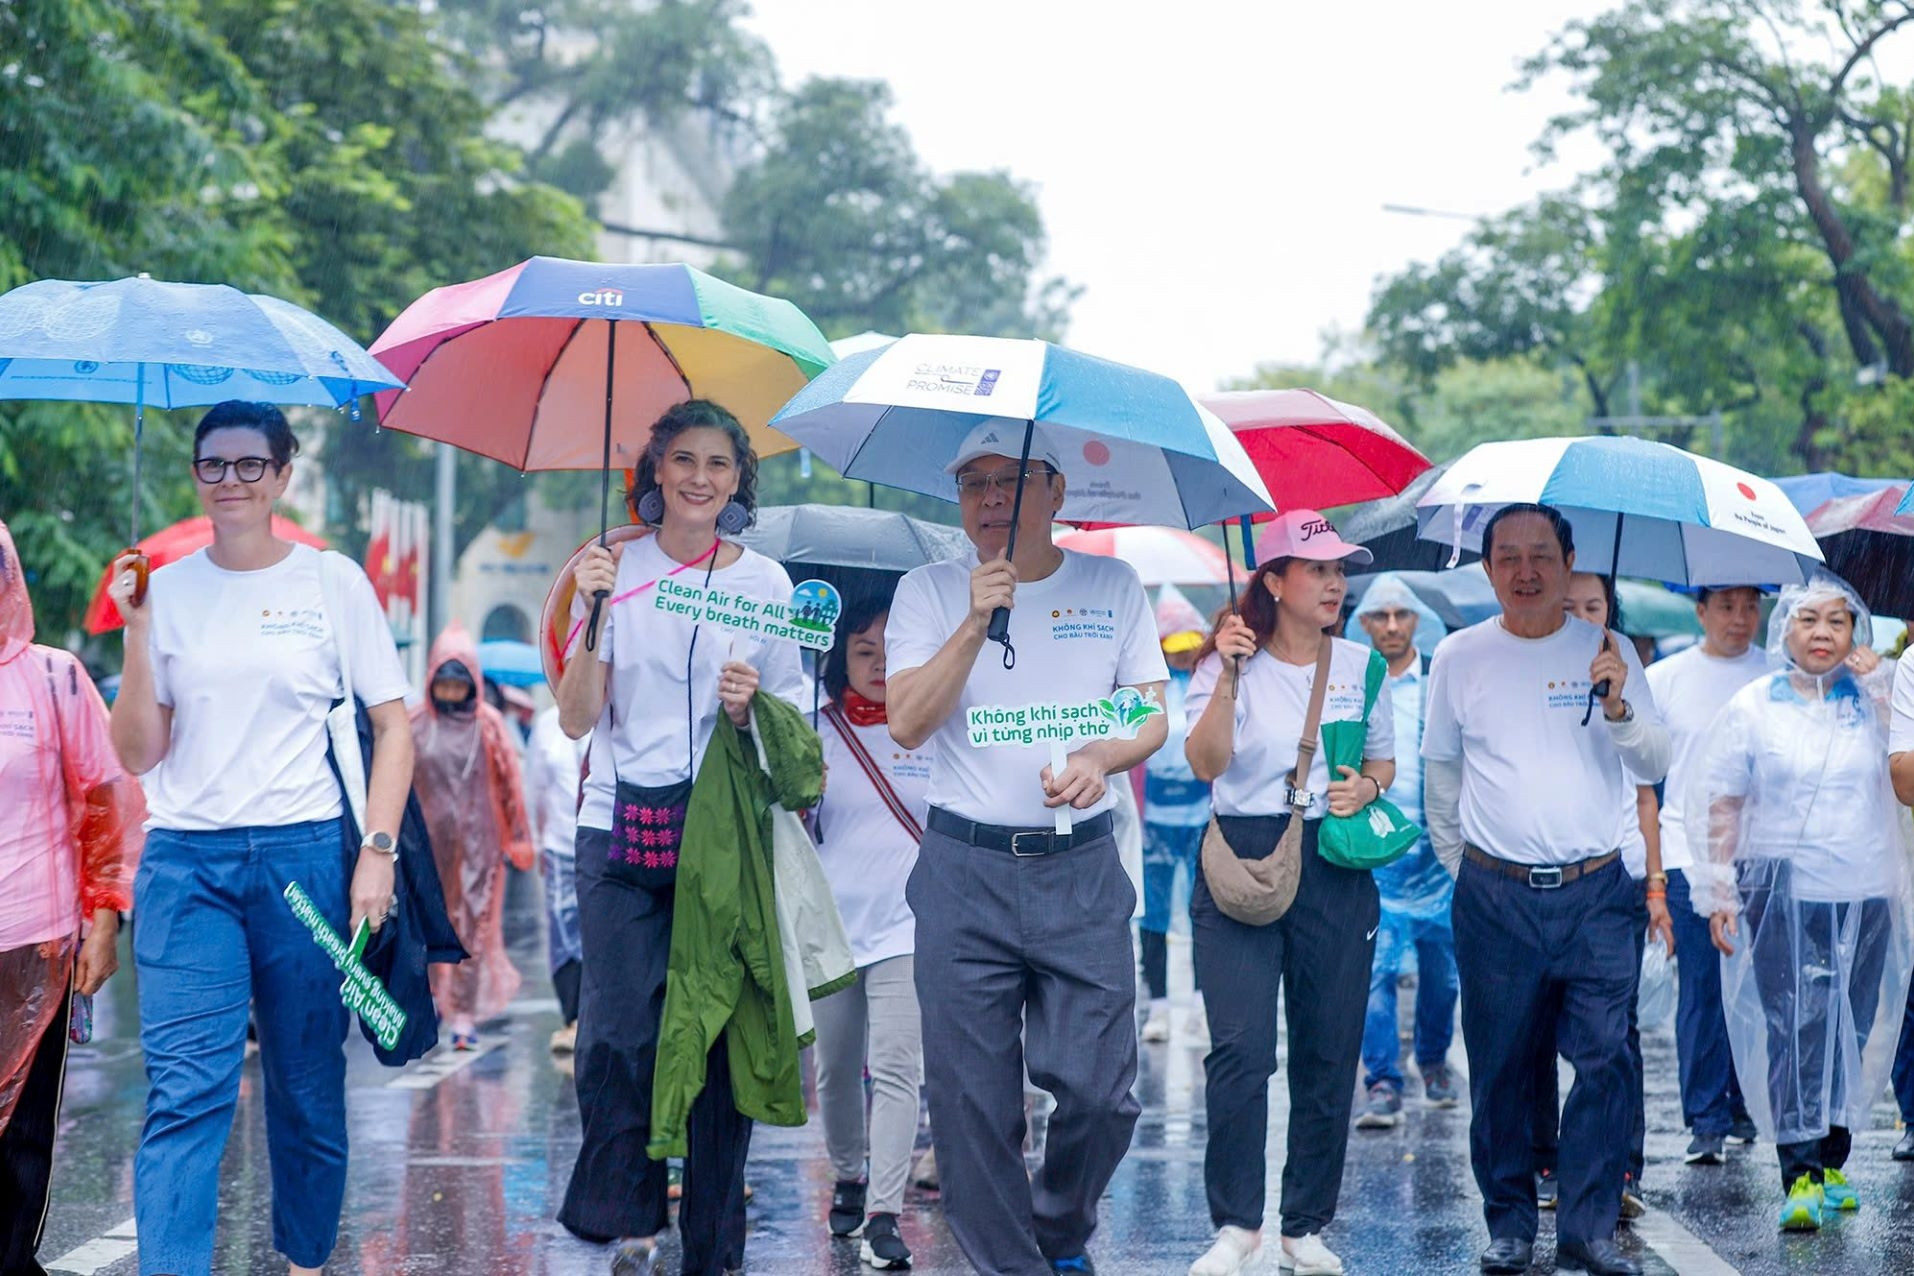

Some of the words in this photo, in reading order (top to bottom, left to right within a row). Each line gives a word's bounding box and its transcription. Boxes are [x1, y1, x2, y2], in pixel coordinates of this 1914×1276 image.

[578, 289, 623, 307] citi
[915, 363, 981, 377] CLIMATE
[906, 379, 975, 396] PROMISE
[658, 578, 702, 601] Clean
[706, 590, 730, 607] Air
[734, 595, 759, 613] for
[762, 602, 784, 620] All
[655, 595, 702, 621] Every
[705, 606, 759, 632] breath
[763, 622, 830, 647] matters
[971, 709, 1026, 726] Không
[1030, 704, 1056, 721] khí
[1061, 703, 1098, 723] sạch
[973, 727, 988, 744] vì
[992, 724, 1033, 744] từng
[1037, 722, 1074, 742] nhịp
[1078, 720, 1110, 736] thở
[345, 954, 372, 990] every
[344, 980, 366, 1008] Air
[369, 980, 406, 1029] Making
[364, 999, 398, 1046] Clean
